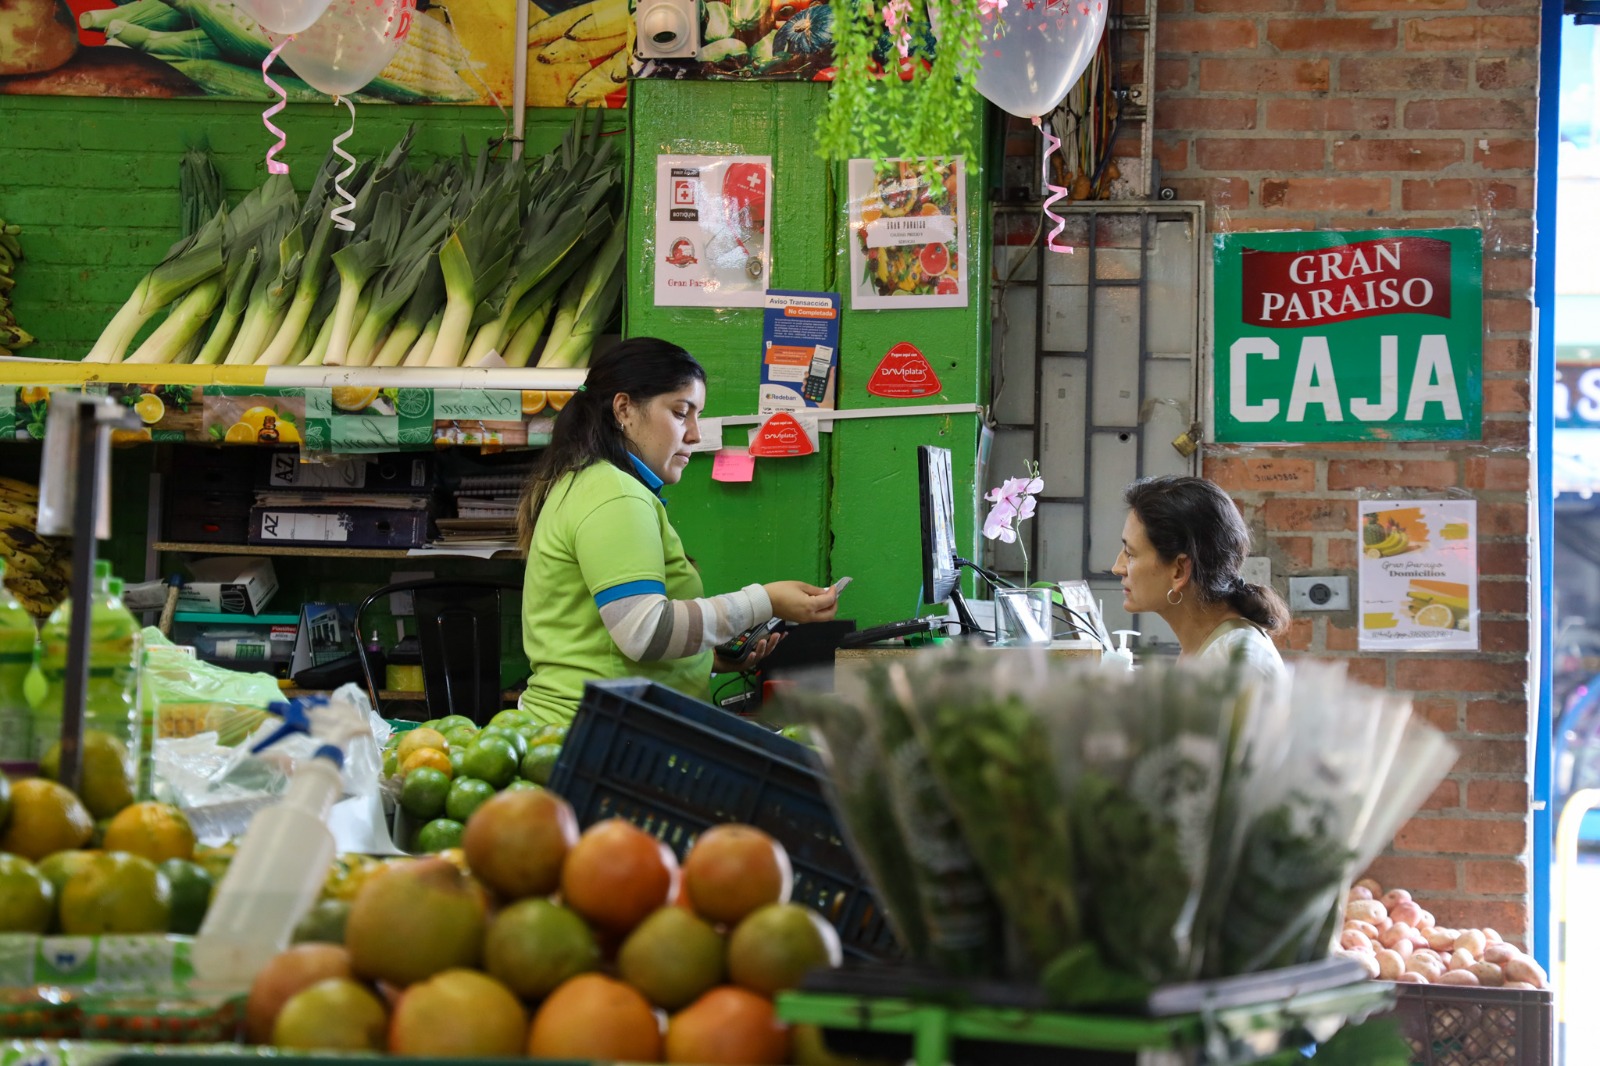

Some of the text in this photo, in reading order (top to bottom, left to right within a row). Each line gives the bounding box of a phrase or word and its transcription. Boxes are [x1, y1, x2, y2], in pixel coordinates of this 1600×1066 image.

[1288, 241, 1403, 285] GRAN
[667, 278, 716, 288] Gran Para
[789, 298, 829, 307] Transacción
[1259, 277, 1434, 322] PARAISO
[798, 309, 833, 317] Completada
[1229, 334, 1464, 423] CAJA
[275, 456, 295, 483] AZ
[264, 514, 278, 537] AZ
[1381, 561, 1404, 570] Gran
